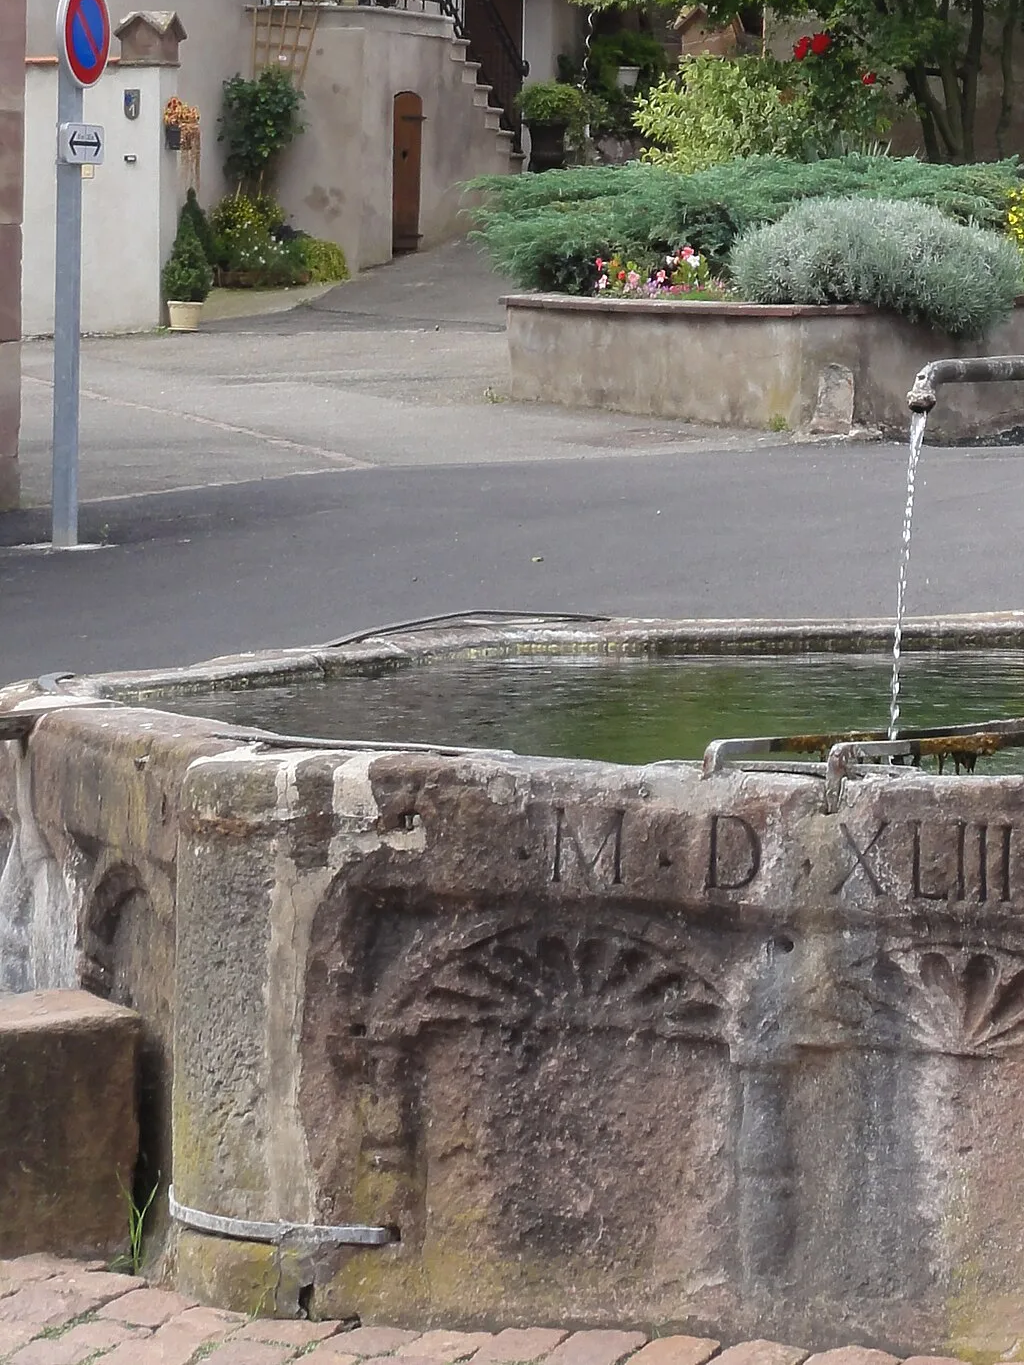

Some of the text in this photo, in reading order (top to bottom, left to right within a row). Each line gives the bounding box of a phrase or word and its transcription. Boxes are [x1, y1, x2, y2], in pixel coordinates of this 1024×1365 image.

[128, 104, 135, 116] 1
[551, 806, 626, 886] M
[703, 814, 763, 890] D
